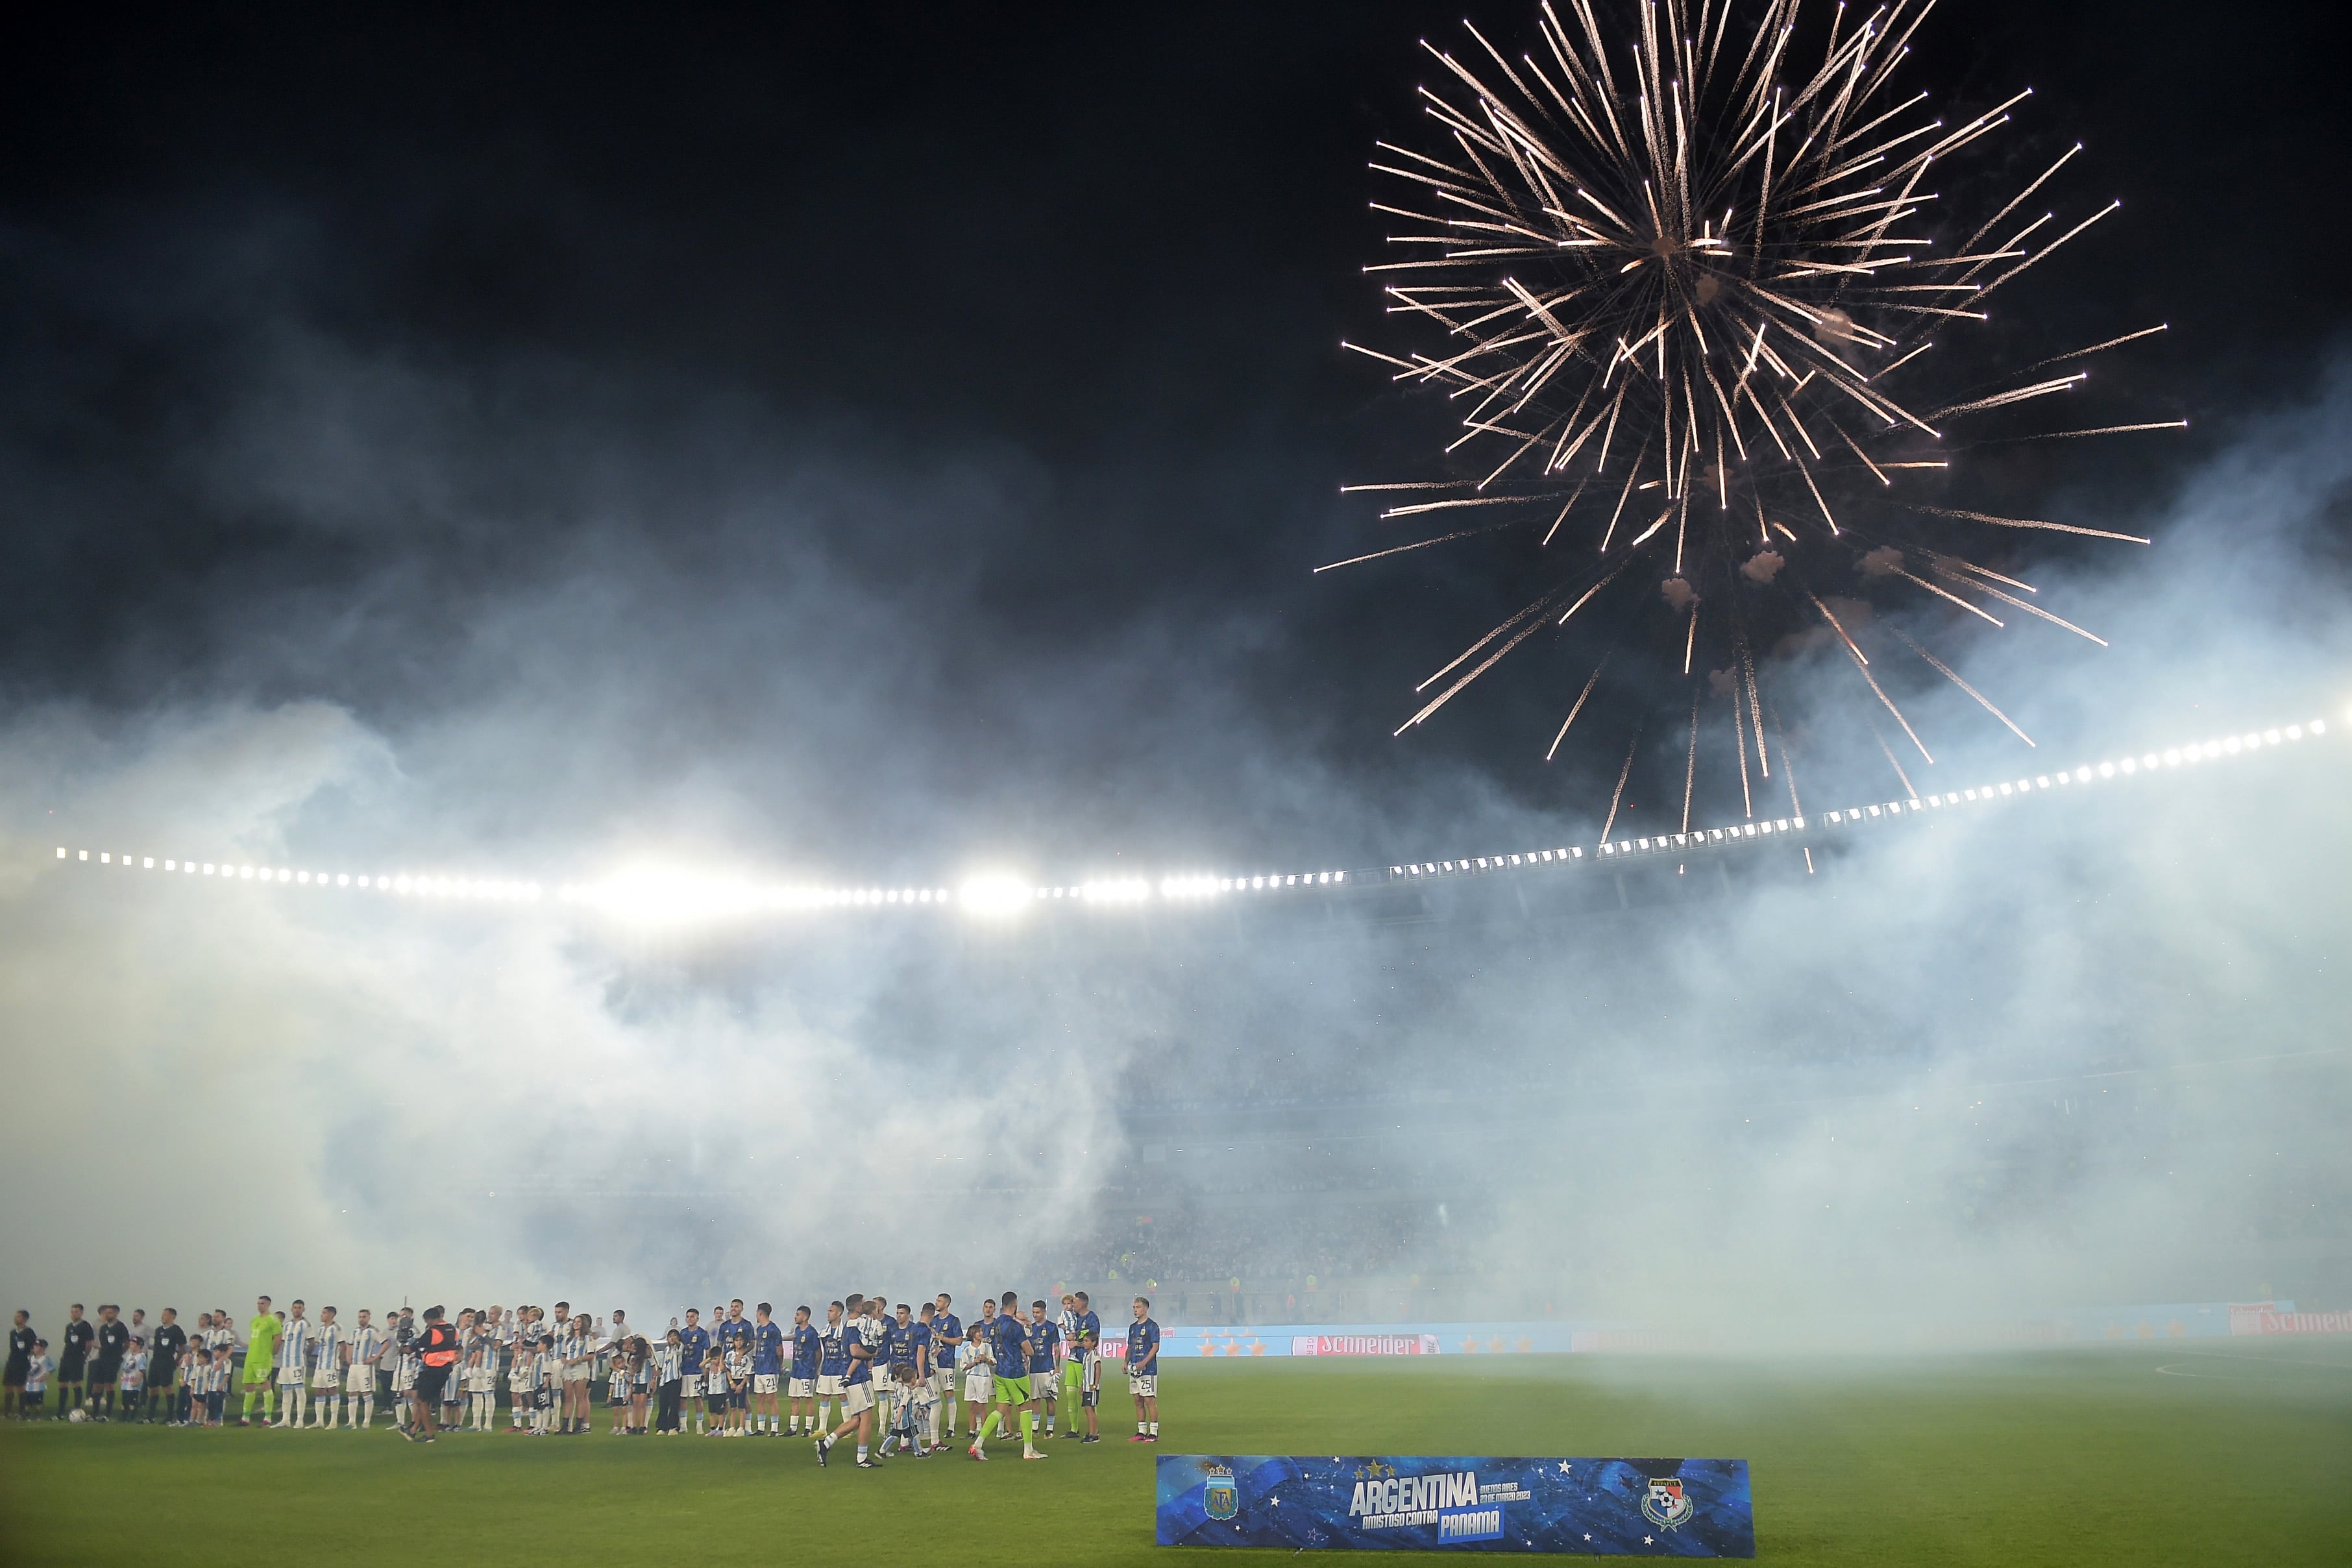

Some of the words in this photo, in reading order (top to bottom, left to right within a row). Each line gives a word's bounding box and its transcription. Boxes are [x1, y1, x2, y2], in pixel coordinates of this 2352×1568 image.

[1322, 1336, 1415, 1354] Schneider
[766, 1377, 776, 1388] 21
[882, 1375, 887, 1384] 6
[944, 1374, 953, 1383] 18
[802, 1381, 810, 1390] 15
[1140, 1379, 1151, 1390] 25
[537, 1392, 546, 1403] 19
[1480, 1484, 1501, 1494] BUENOS
[1502, 1482, 1518, 1492] AIRES
[1349, 1471, 1478, 1517] ARGENTINA
[1480, 1494, 1488, 1504] 23
[1488, 1493, 1495, 1502] DE
[1495, 1491, 1515, 1502] MARZO
[1516, 1490, 1531, 1501] 2023
[1362, 1513, 1405, 1530] AMISTOSO
[1406, 1510, 1438, 1526] CONTRA
[1440, 1505, 1500, 1537] PANAMÁ
